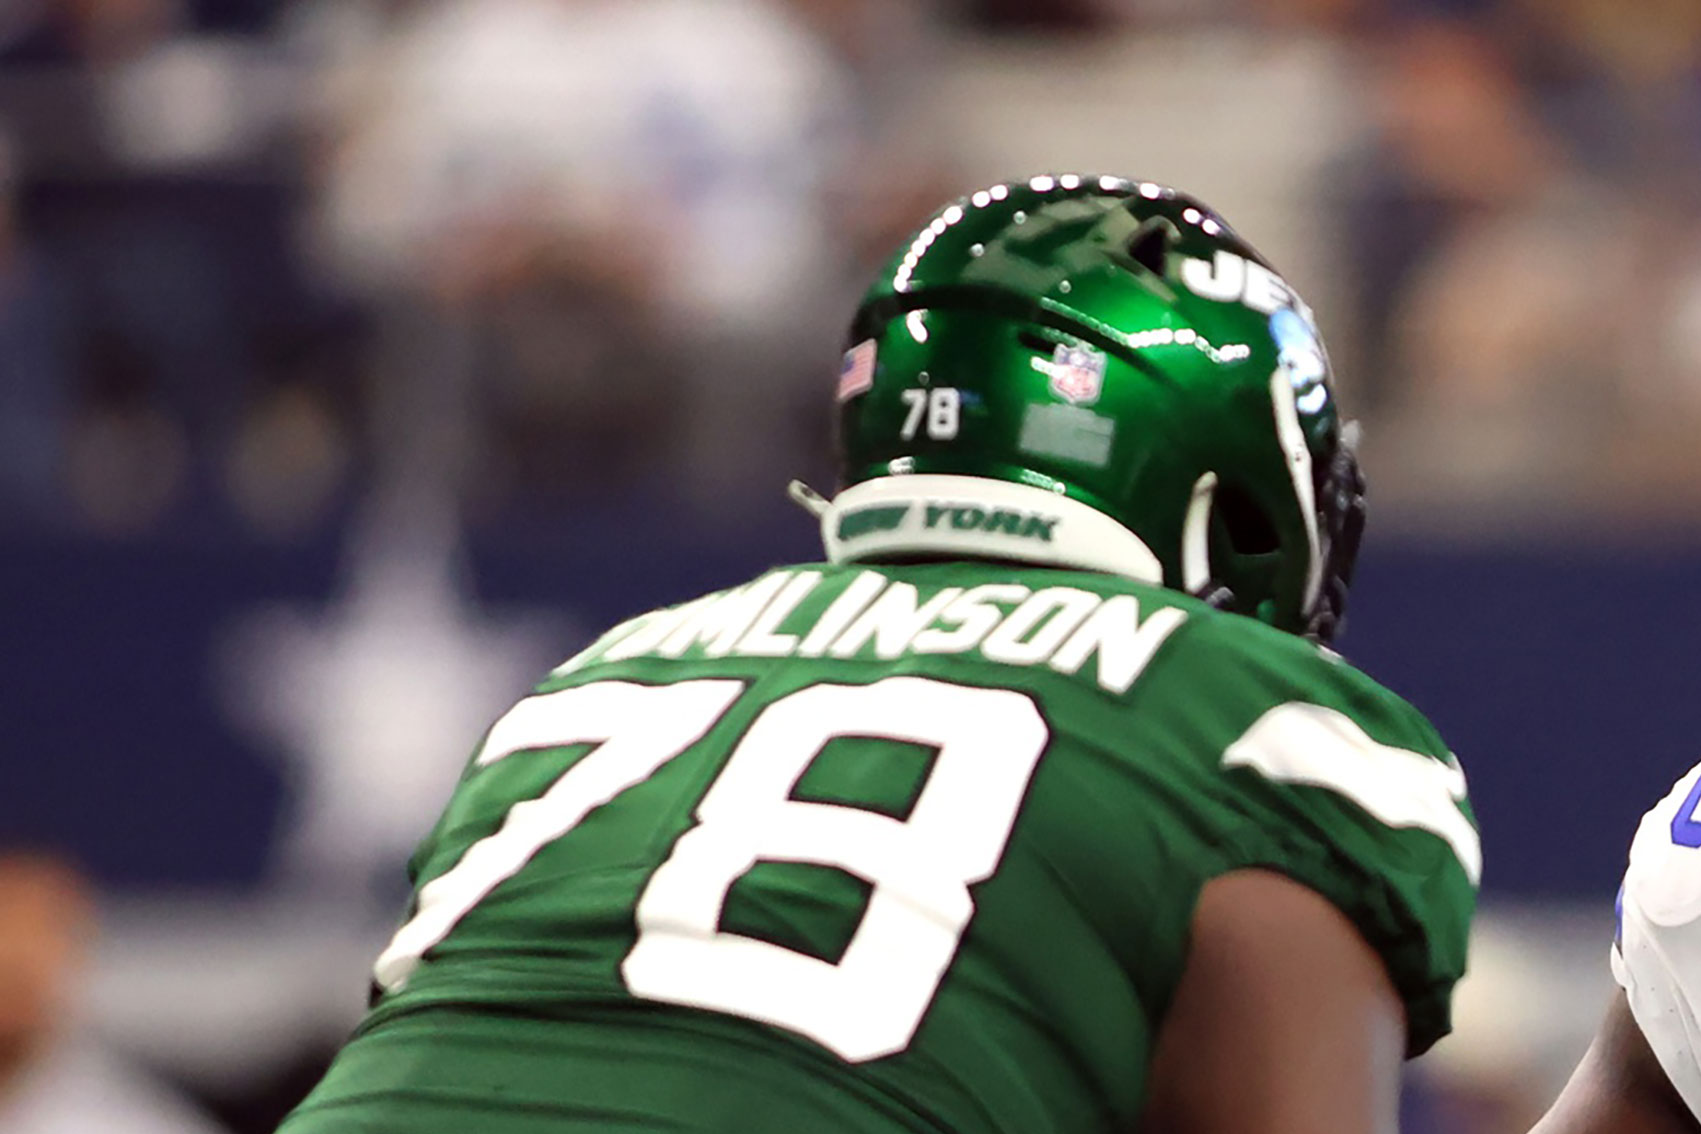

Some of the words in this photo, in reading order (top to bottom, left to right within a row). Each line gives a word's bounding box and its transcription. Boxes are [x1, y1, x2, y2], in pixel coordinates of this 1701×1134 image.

[901, 386, 960, 441] 78
[923, 504, 1062, 543] YORK
[370, 675, 1050, 1063] 78
